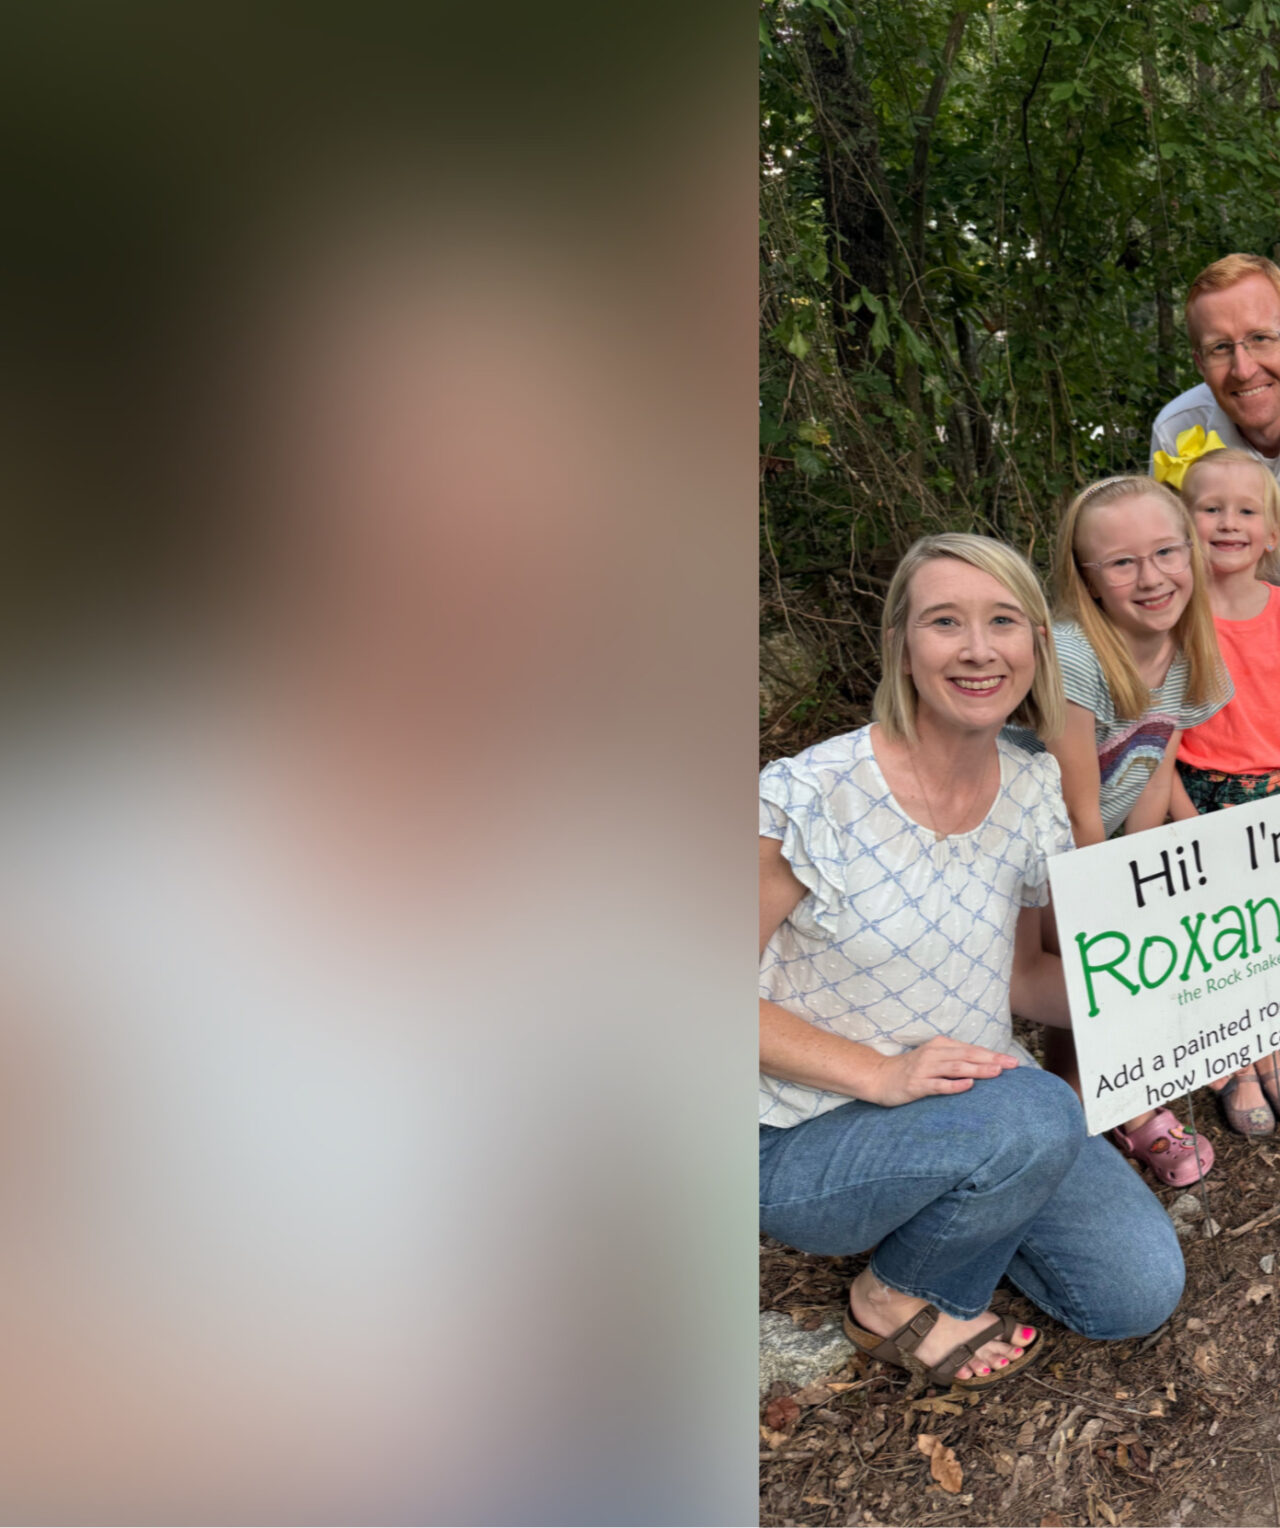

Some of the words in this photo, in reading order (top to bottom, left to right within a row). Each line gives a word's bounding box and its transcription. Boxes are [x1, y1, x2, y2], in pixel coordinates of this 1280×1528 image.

[1129, 840, 1207, 908] Hi!
[1177, 987, 1202, 1006] the
[1206, 969, 1242, 994] Rock
[1096, 1057, 1144, 1098] Add
[1152, 1054, 1166, 1071] a
[1173, 1009, 1251, 1067] painted
[1145, 1069, 1196, 1105] how
[1205, 1044, 1252, 1078] long
[1256, 1033, 1263, 1053] I
